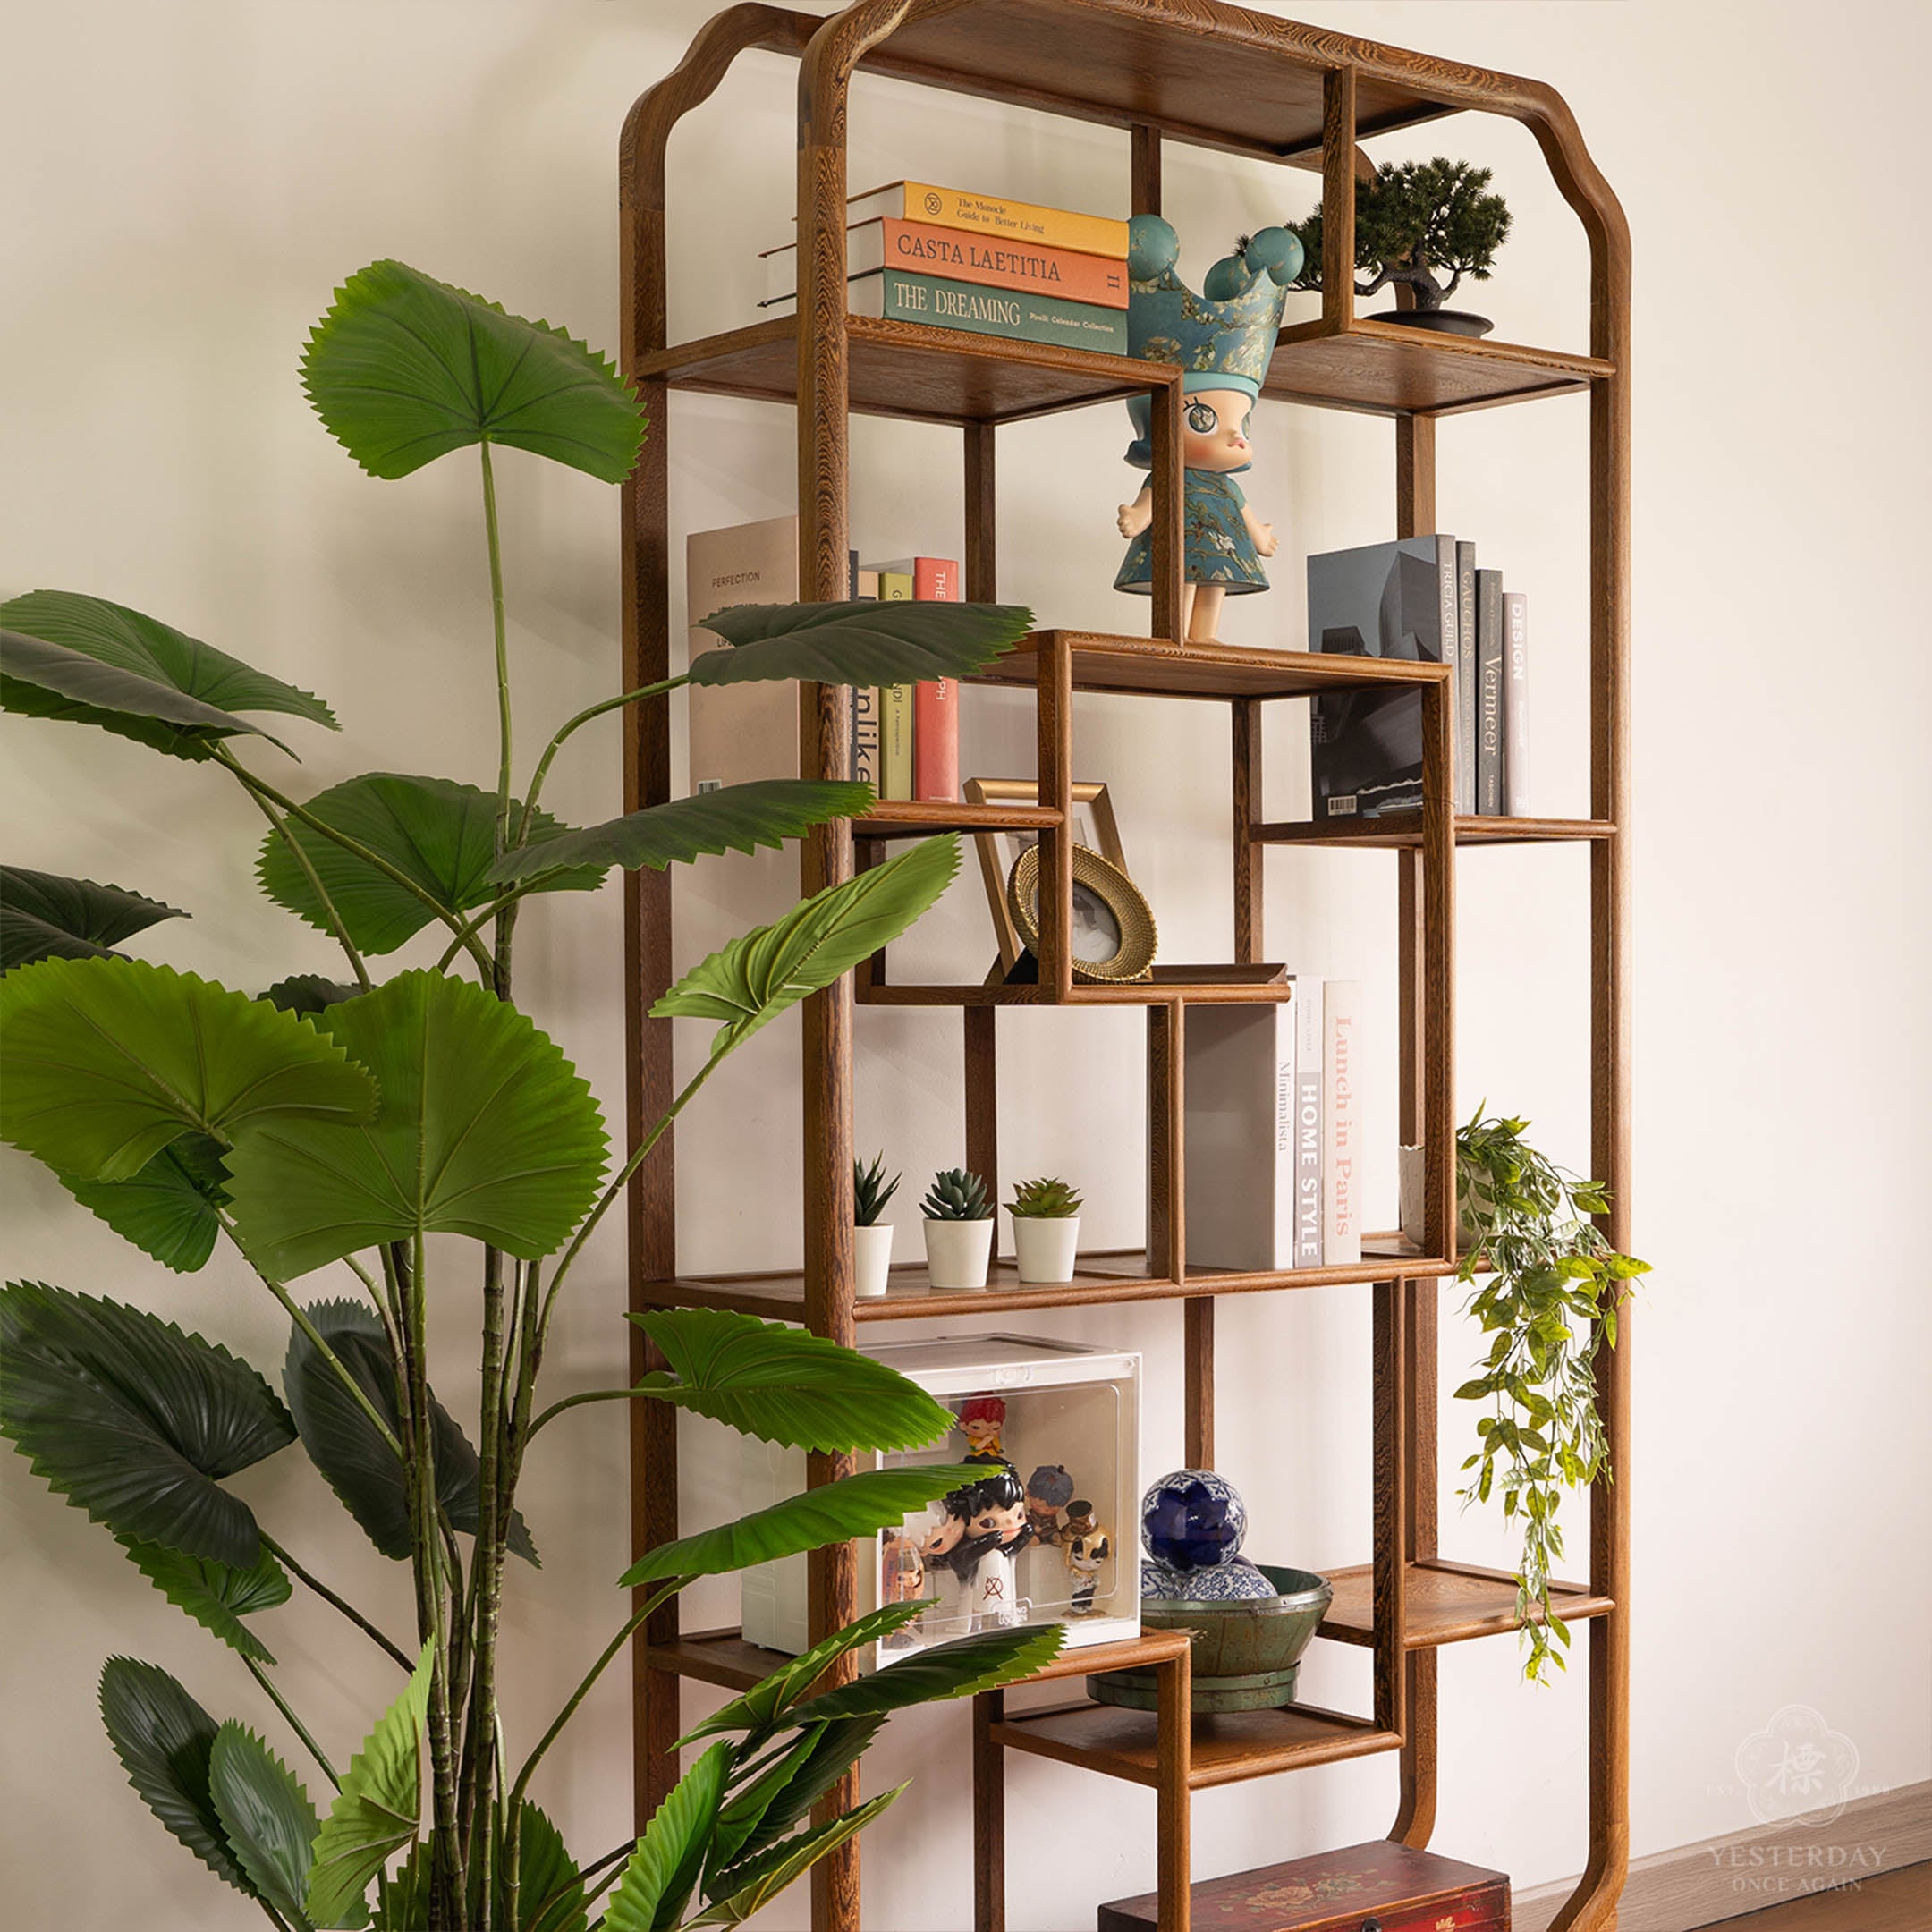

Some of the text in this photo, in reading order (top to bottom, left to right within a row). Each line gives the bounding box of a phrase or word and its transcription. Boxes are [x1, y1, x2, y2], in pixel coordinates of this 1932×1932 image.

[956, 208, 1045, 234] Guide to Better Living
[957, 198, 1007, 215] The Monocle
[897, 234, 1062, 283] CASTA LAETITIA
[894, 283, 1021, 326] THE DREAMING
[711, 571, 760, 588] PERFECTION
[935, 572, 946, 599] THE
[1442, 563, 1455, 657] TRICIA GUILD
[1462, 572, 1474, 659] GAUCHOS
[1511, 603, 1525, 680] DESIGN
[1484, 656, 1503, 756] Vermeer
[1278, 1061, 1291, 1152] Minimalista
[1335, 1016, 1353, 1237] Lunch in Paris
[1301, 1084, 1318, 1257] HOME STYLE
